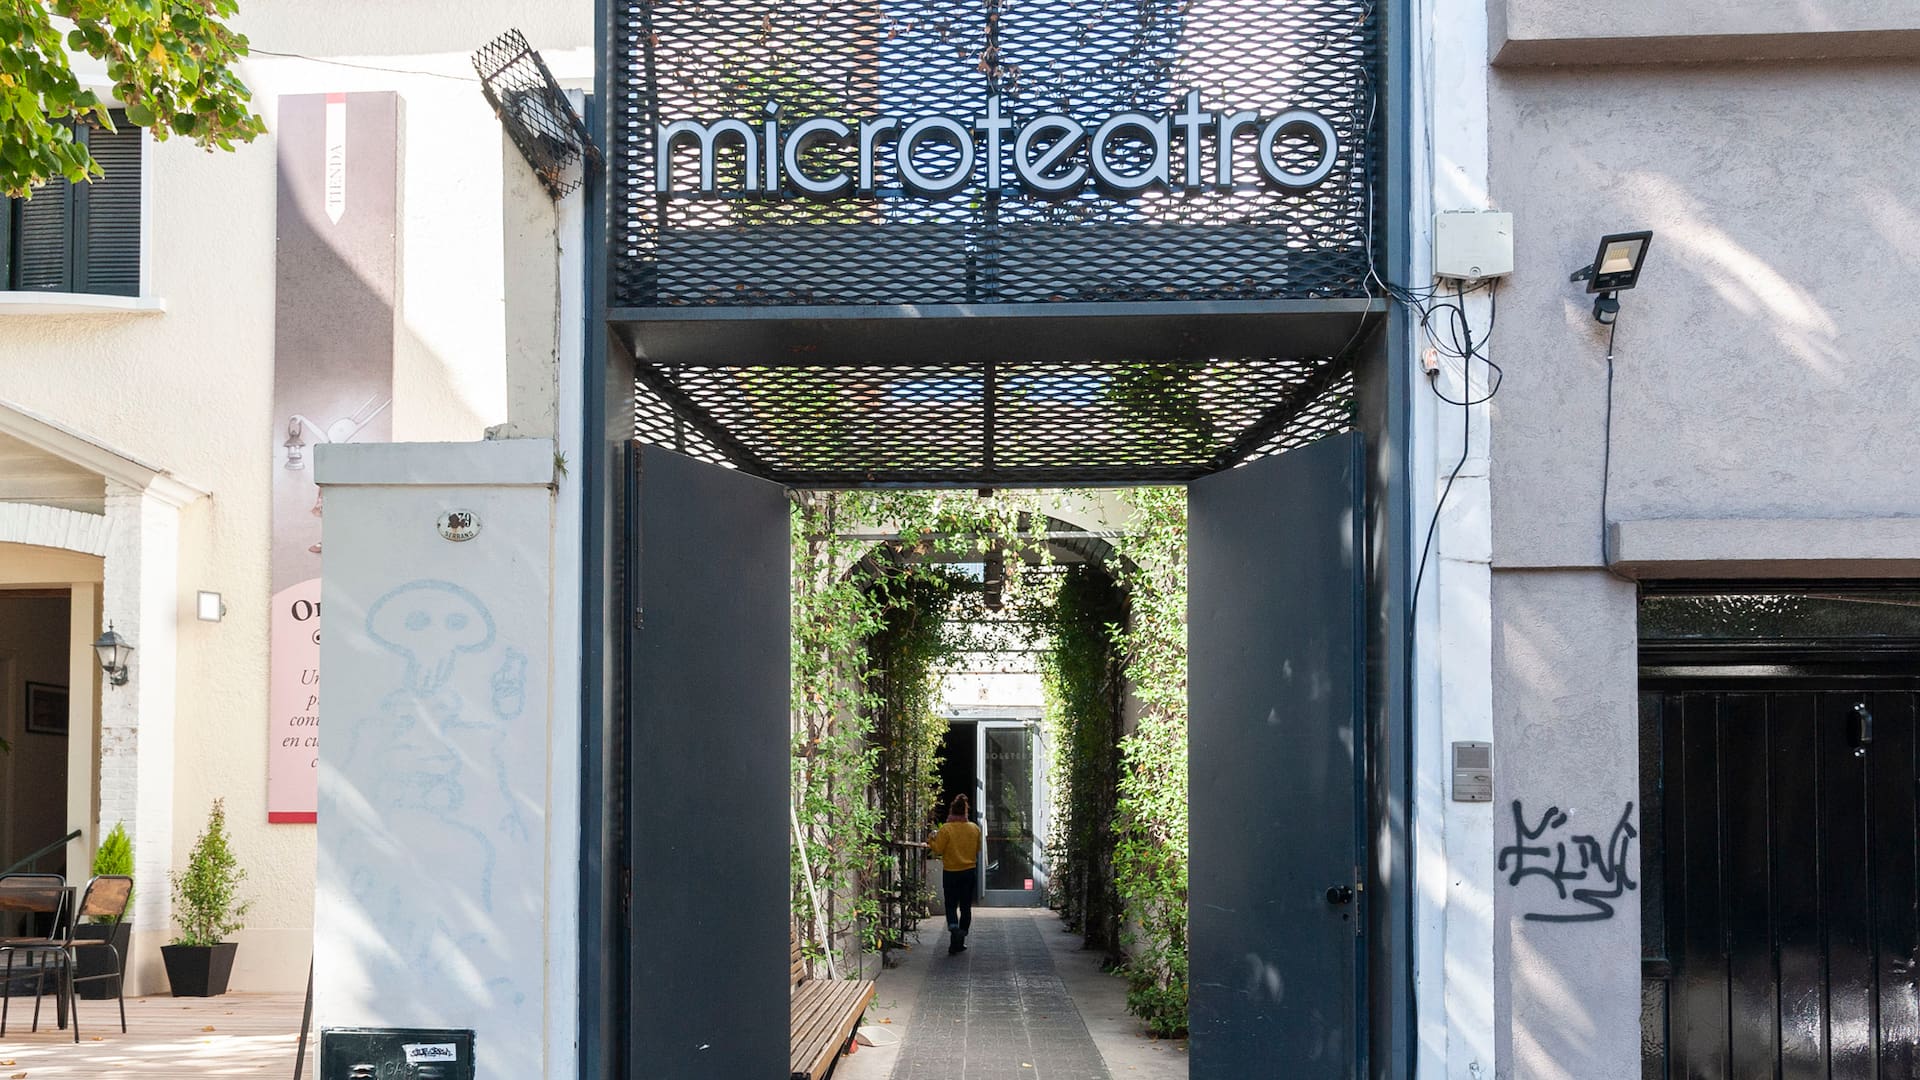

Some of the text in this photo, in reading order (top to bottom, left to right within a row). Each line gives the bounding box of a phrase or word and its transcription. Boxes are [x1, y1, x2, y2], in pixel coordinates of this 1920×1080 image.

[656, 90, 1338, 193] microteatro
[329, 145, 342, 207] TIENDA
[444, 530, 474, 539] SERRANO
[282, 736, 299, 747] en
[385, 1061, 415, 1076] GAS
